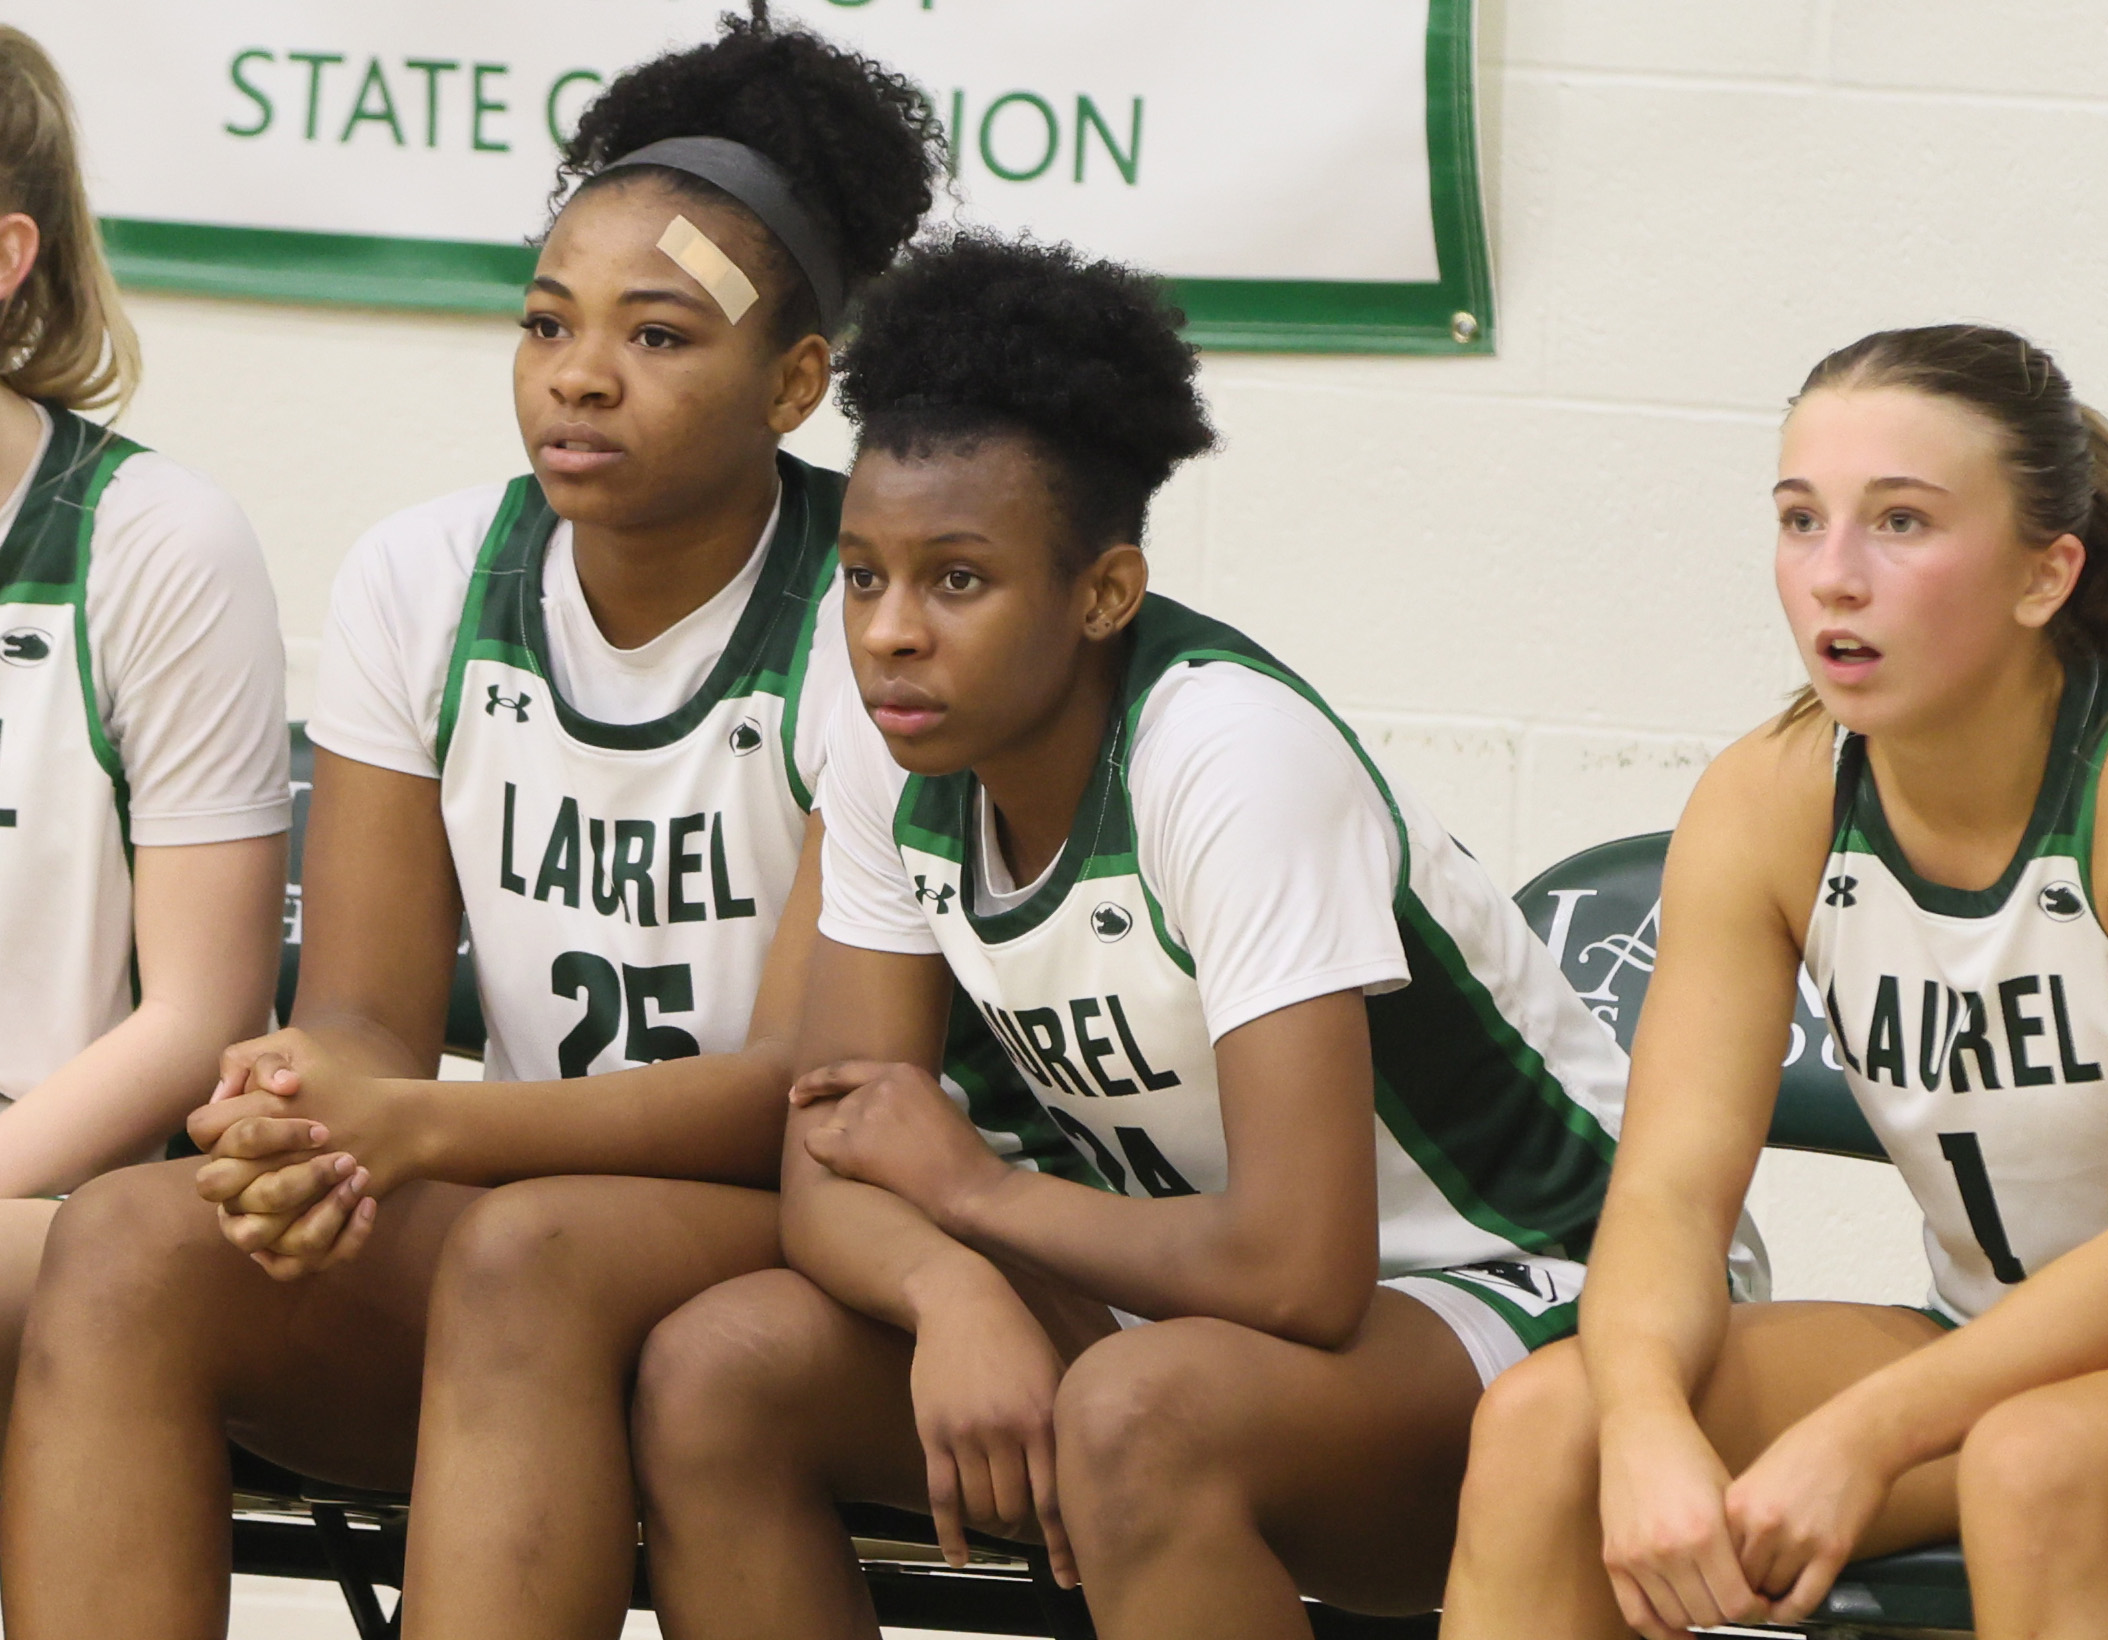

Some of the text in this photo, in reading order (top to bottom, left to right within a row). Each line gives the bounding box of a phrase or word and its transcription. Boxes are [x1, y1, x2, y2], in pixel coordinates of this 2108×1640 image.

[225, 49, 1144, 185] STATE CION
[500, 781, 757, 928] LAUREL
[551, 950, 701, 1080] 25
[981, 994, 1182, 1098] UREL
[1937, 1131, 2028, 1285] 1
